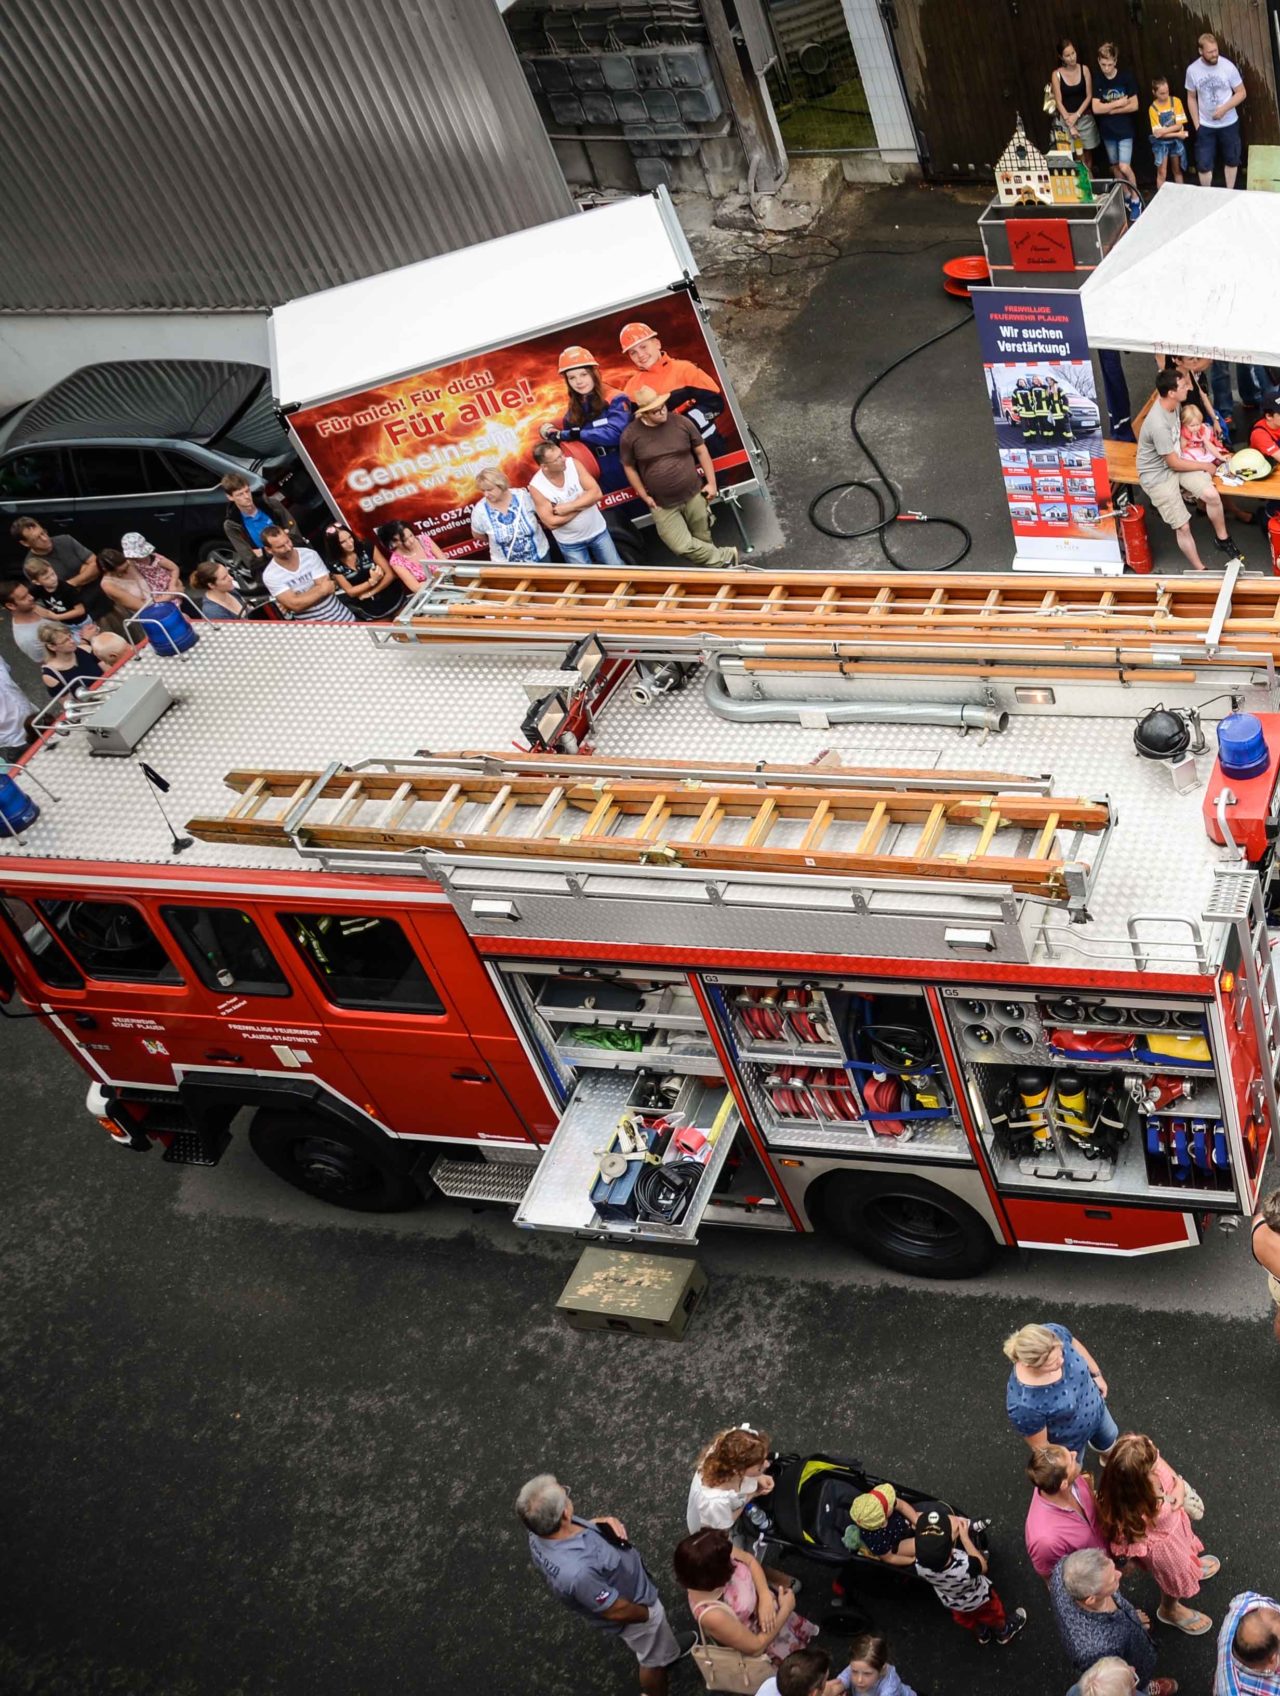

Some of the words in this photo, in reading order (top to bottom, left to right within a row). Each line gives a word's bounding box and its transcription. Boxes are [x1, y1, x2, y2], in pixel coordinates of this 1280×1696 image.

[1004, 304, 1052, 314] FREIWILLIGE
[990, 313, 1036, 322] FEUERWEHR
[1037, 315, 1070, 323] PLAUEN
[999, 325, 1019, 338] Wir
[1022, 327, 1064, 340] suchen
[997, 340, 1071, 357] Verstärkung!
[316, 417, 352, 438] Für
[354, 398, 408, 426] mich!
[410, 388, 442, 408] Für
[447, 370, 494, 396] dich!
[383, 410, 446, 447] Für
[458, 378, 535, 425] alle!
[346, 424, 519, 492] Gemeinsam
[359, 483, 419, 512] geben
[420, 467, 449, 490] wir
[604, 491, 633, 507] dich.
[414, 516, 440, 530] Tel.:
[418, 517, 472, 537] Jugendfeue
[705, 975, 719, 983] G3
[944, 988, 959, 997] G5
[112, 1016, 157, 1025] FEUERWEHR
[136, 1023, 166, 1031] PLAUEN
[228, 1023, 274, 1033] FREIWILLIGE
[274, 1026, 322, 1037] FEUERWEHR
[242, 1033, 318, 1044] PLAUEN-STADTMITTE
